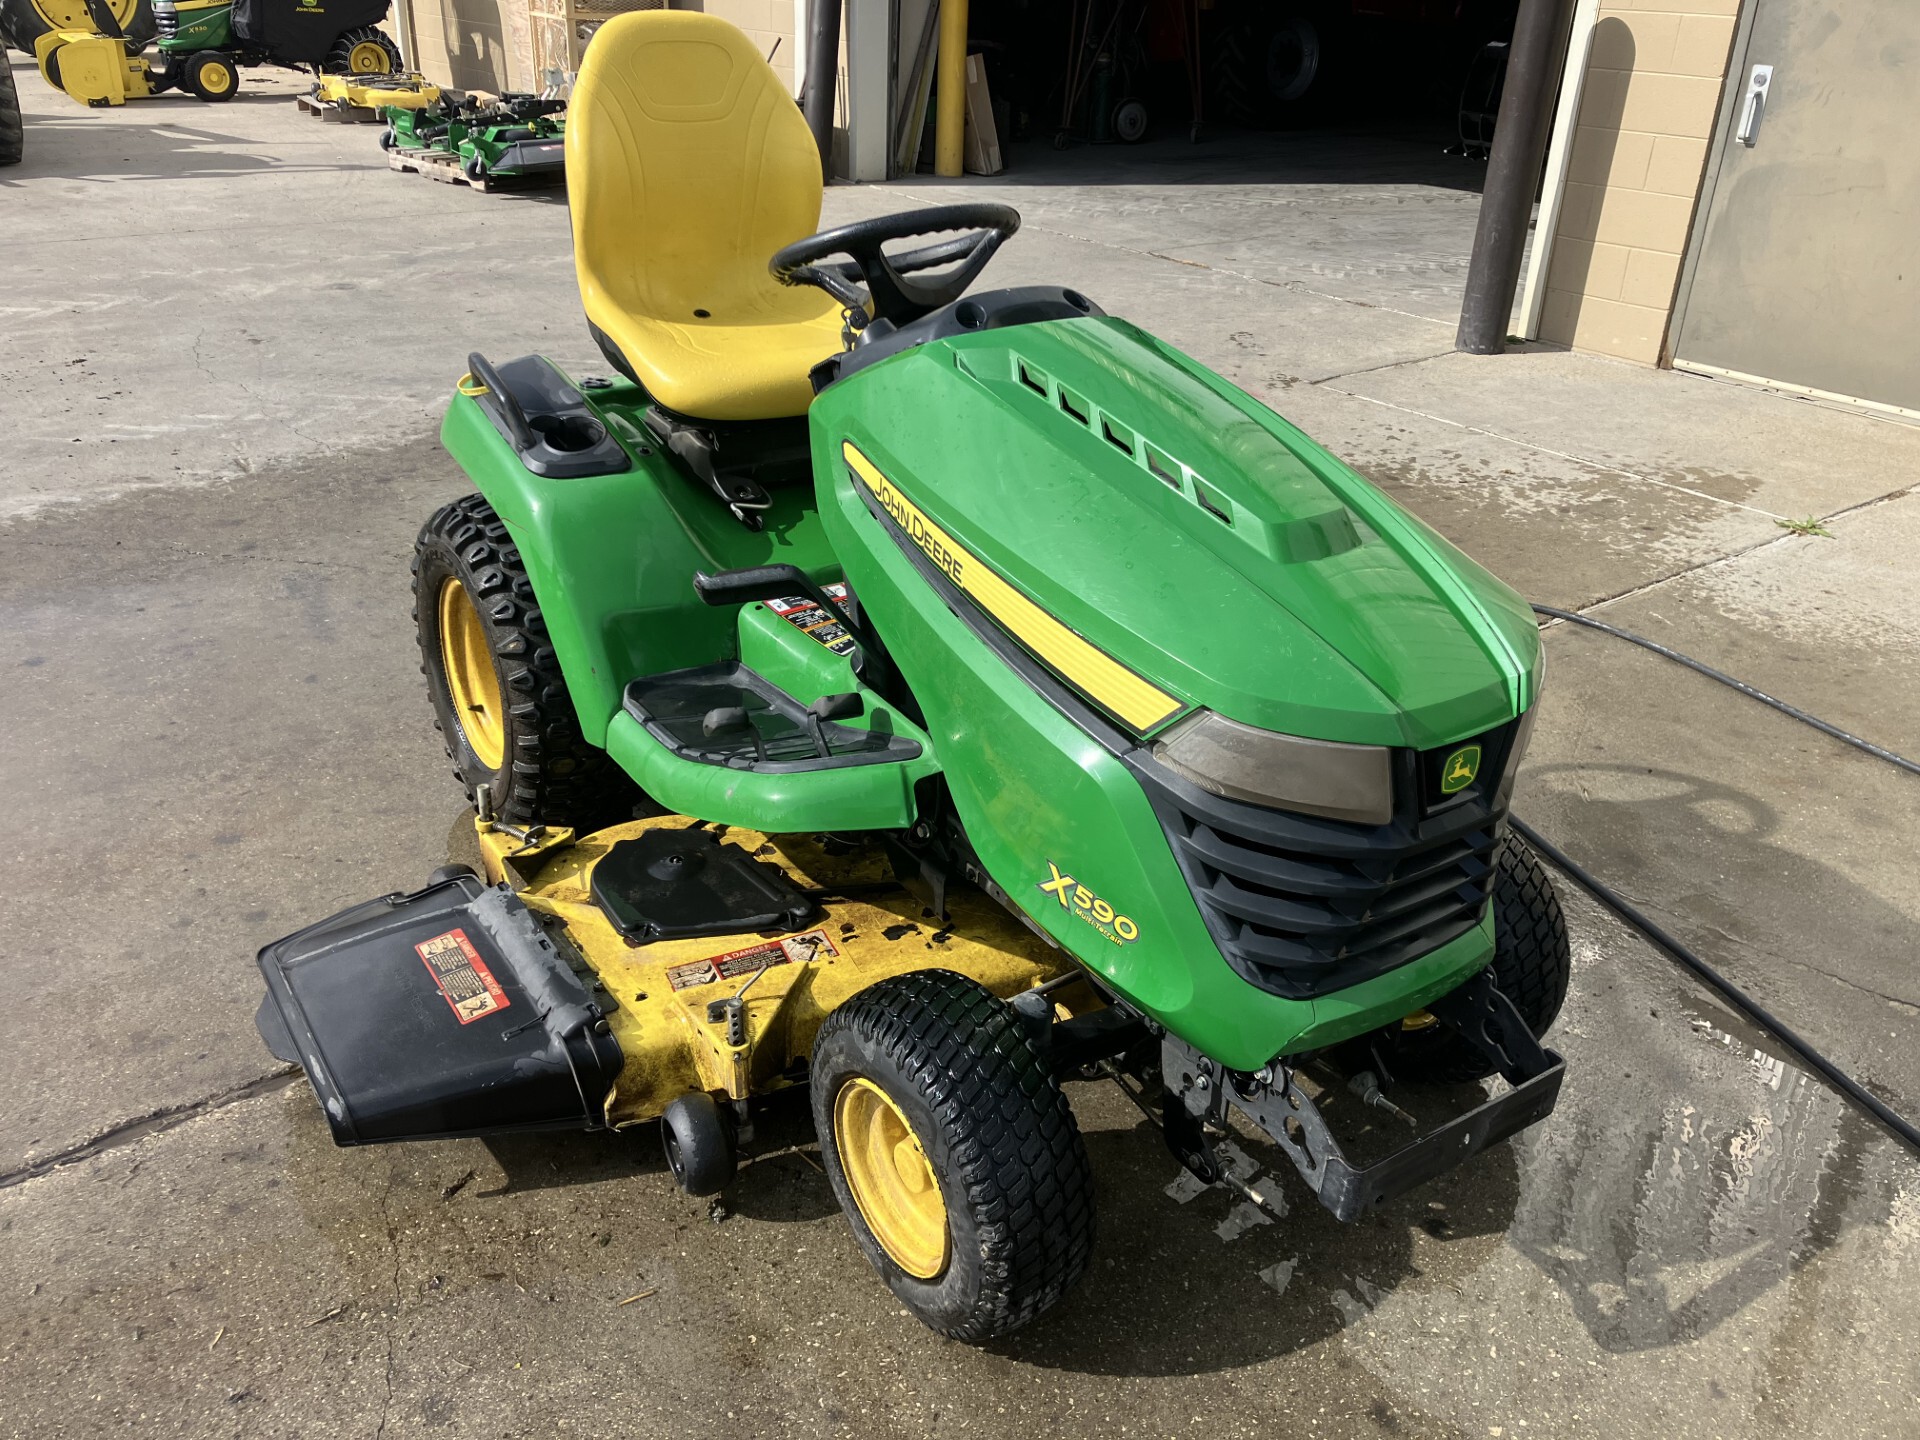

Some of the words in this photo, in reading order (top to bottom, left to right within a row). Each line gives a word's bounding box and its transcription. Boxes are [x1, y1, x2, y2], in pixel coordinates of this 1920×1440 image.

[874, 477, 910, 530] JOHN
[912, 513, 964, 584] DEERE
[1037, 859, 1140, 942] X590
[731, 944, 772, 959] DANGER
